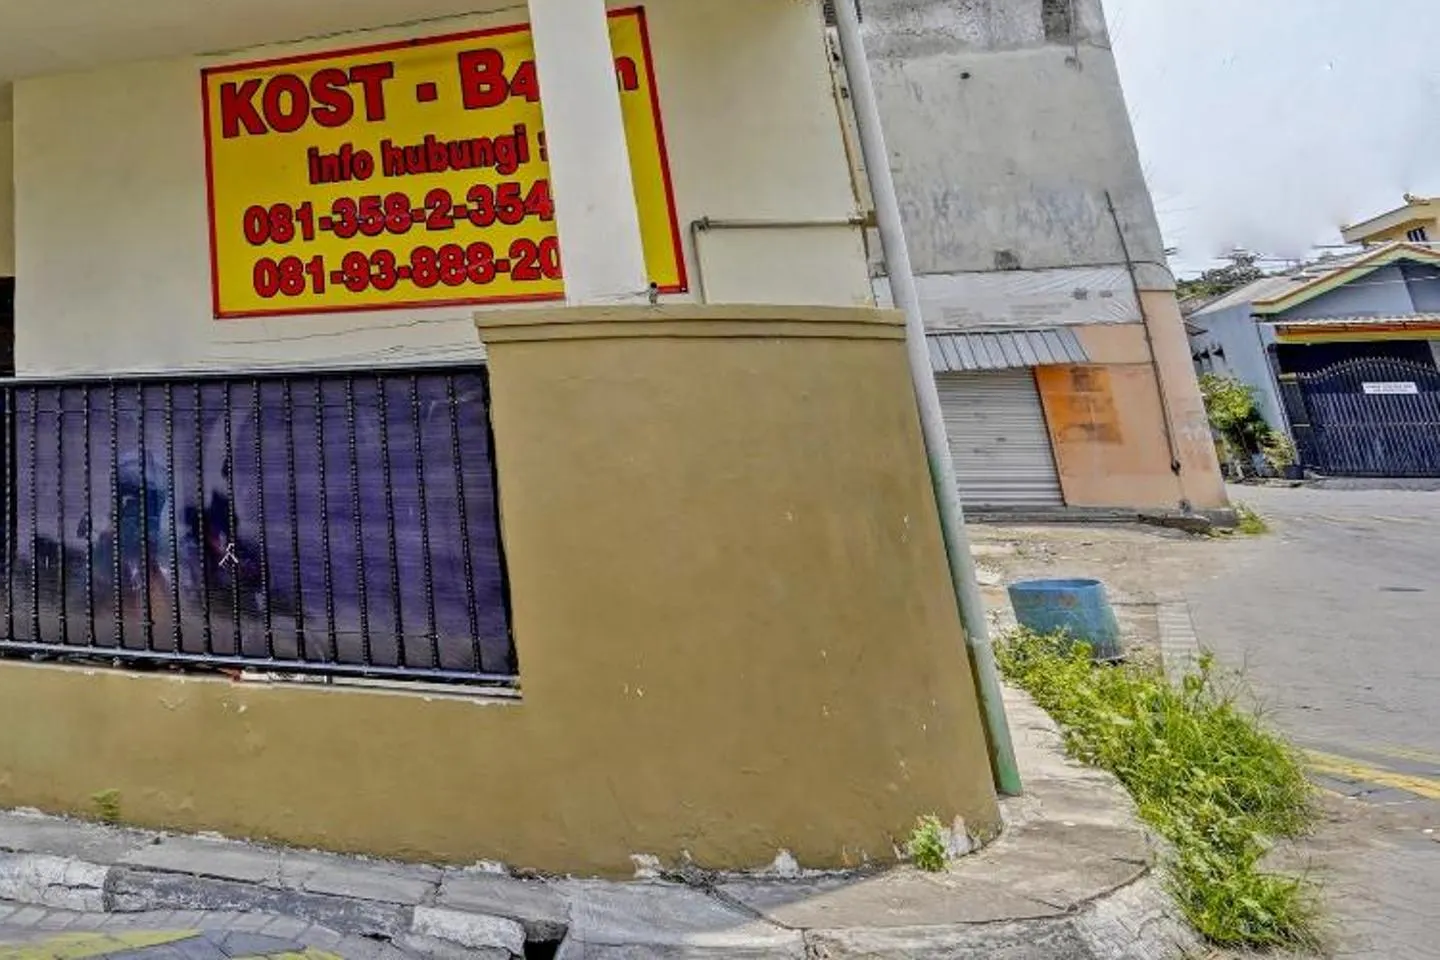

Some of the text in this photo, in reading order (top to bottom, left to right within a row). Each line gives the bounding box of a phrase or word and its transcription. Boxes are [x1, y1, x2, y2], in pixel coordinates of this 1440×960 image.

[220, 61, 394, 139] KOST
[307, 142, 375, 185] info
[380, 122, 530, 177] hubungi
[243, 179, 556, 246] 081-358-2-354
[253, 236, 563, 298] 081-93-888-20
